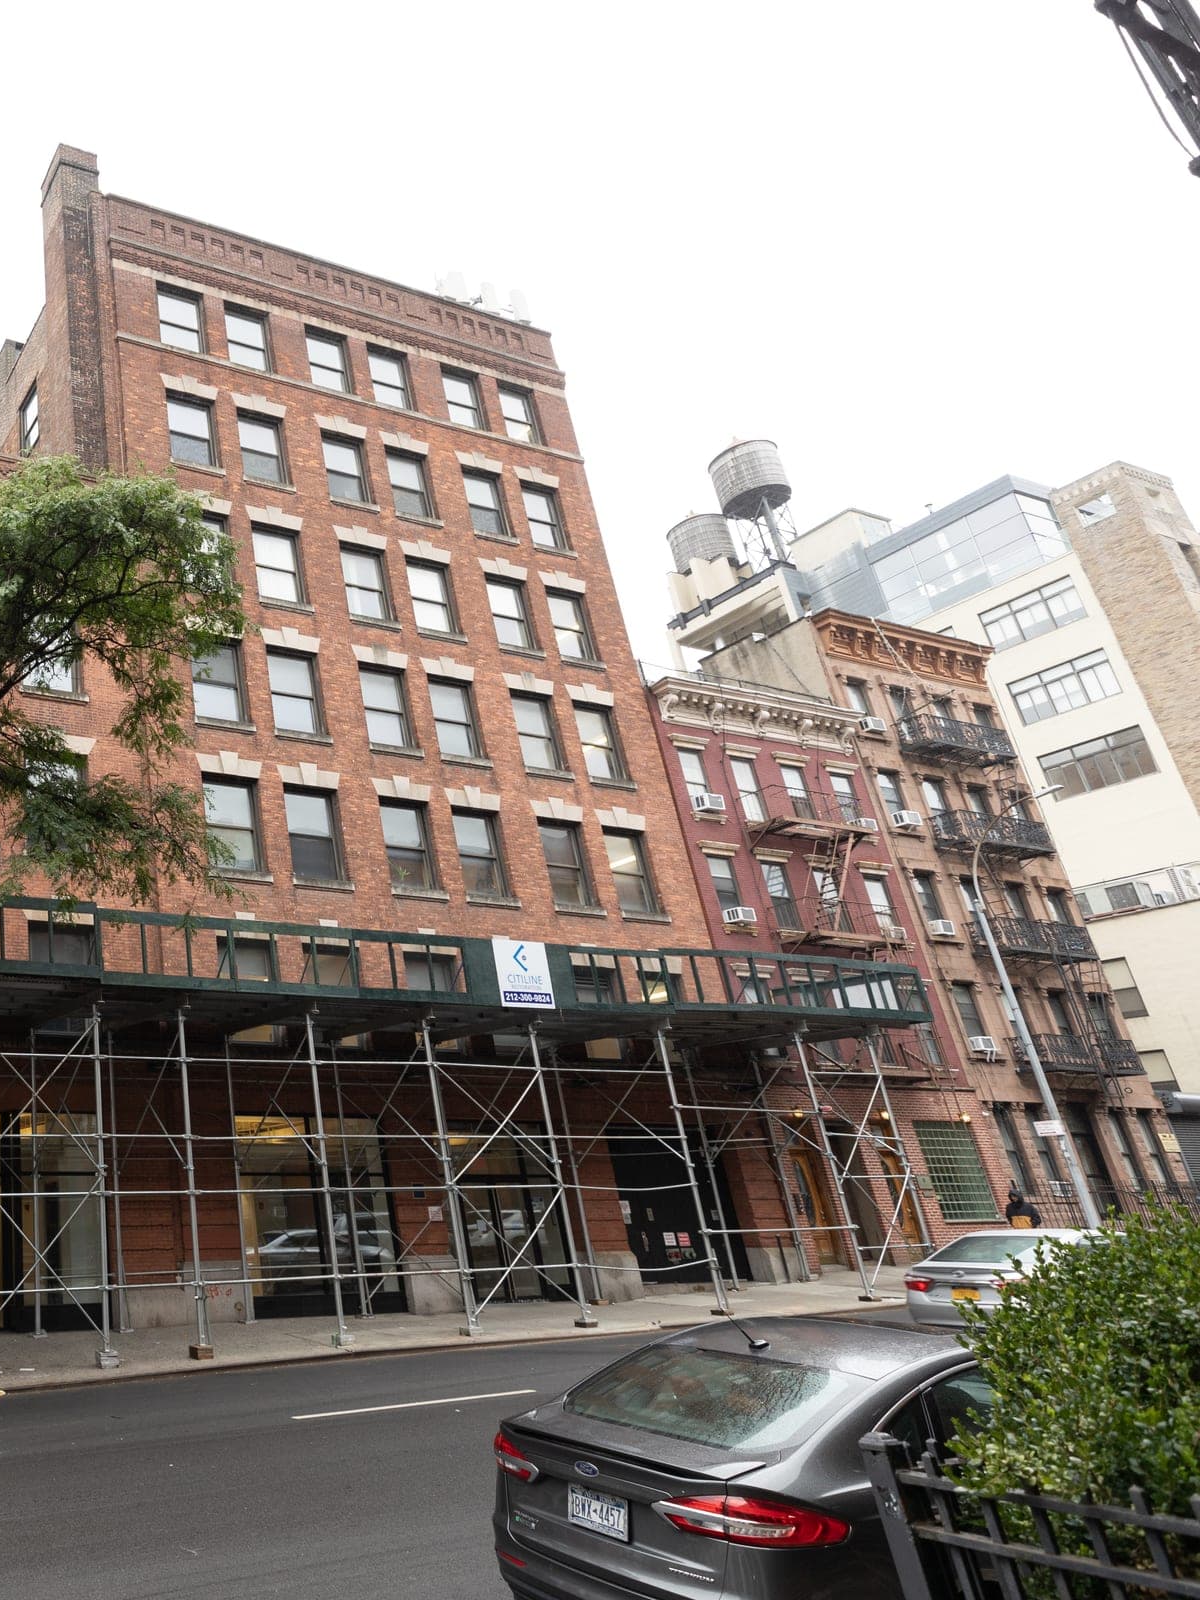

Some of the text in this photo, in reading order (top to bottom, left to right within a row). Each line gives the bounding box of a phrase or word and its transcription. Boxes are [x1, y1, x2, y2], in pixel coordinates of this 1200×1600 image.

[507, 974, 544, 985] CITILINE
[574, 1495, 592, 1519] BWX
[598, 1503, 622, 1529] 4457
